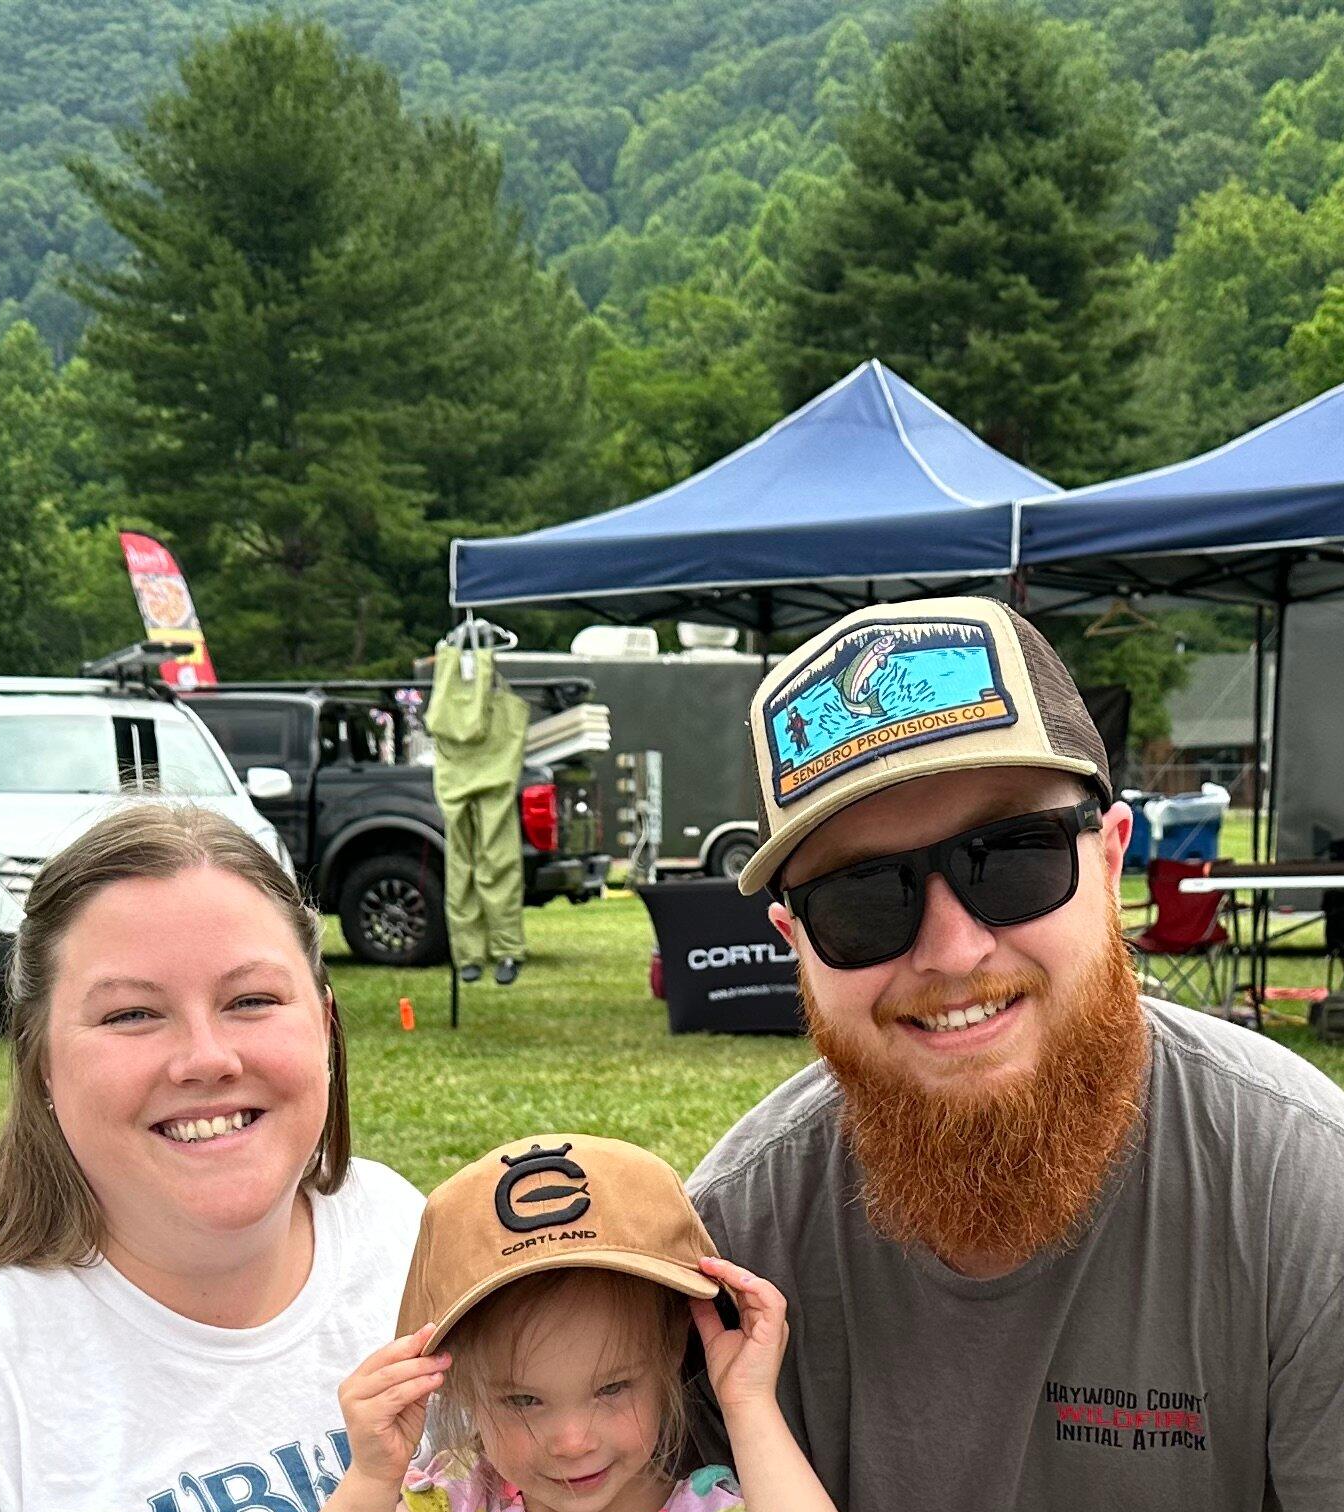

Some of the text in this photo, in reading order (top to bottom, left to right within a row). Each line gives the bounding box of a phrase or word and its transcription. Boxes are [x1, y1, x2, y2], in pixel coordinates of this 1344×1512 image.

[793, 706, 985, 786] SENDERO PROVISIONS CO
[687, 943, 799, 970] CORTL
[501, 1230, 597, 1256] CORTLAND
[1058, 1403, 1206, 1436] WILDFIRE
